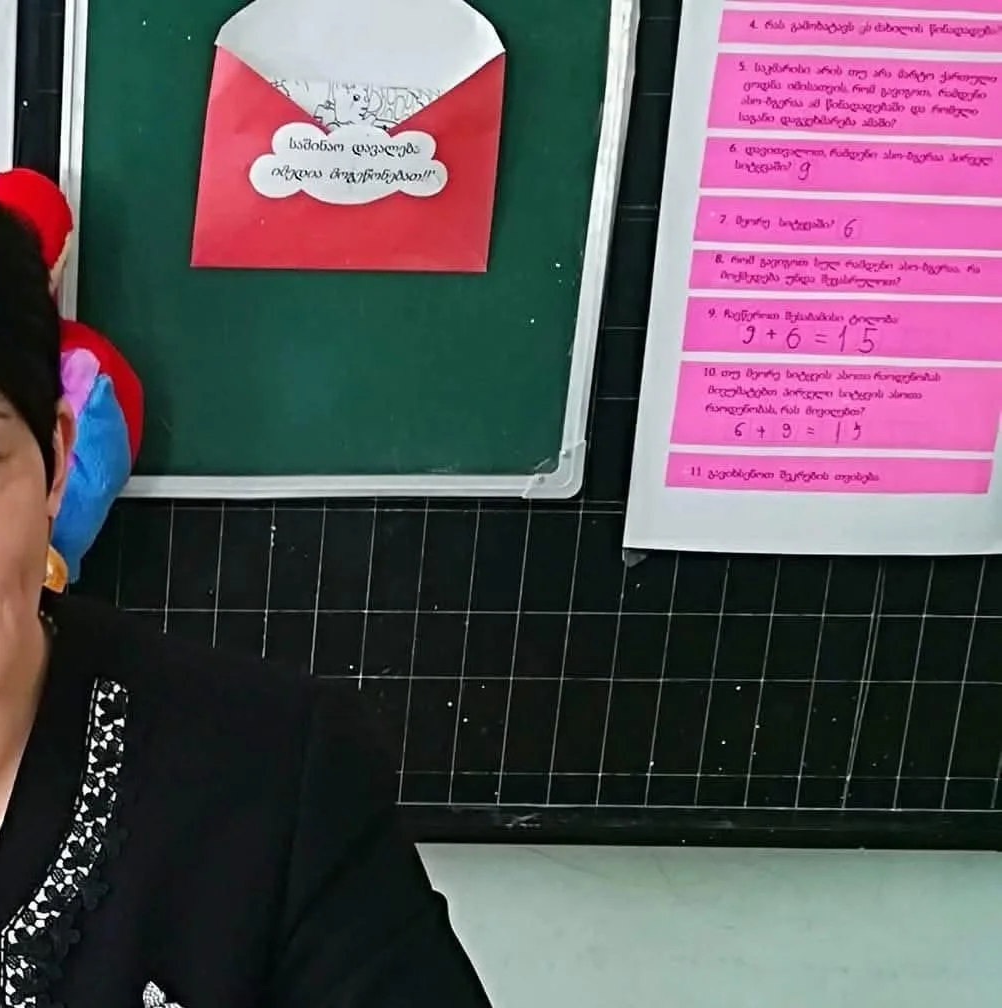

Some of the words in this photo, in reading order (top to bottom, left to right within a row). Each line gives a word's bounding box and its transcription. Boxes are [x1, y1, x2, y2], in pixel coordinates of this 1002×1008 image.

[764, 19, 785, 31] რას
[754, 62, 810, 76] საკმარისი
[815, 65, 843, 77] არის
[847, 69, 868, 81] თუ
[872, 67, 892, 79] არა
[897, 69, 936, 83] მარტო
[939, 71, 998, 86] ქართული
[742, 80, 782, 92] ცოდნა
[851, 83, 876, 95] რომ
[937, 87, 988, 102] რამდენი
[738, 111, 775, 126] საგანი
[909, 103, 926, 116] და
[931, 103, 980, 118] რომელი
[288, 137, 345, 153] საშინაო
[351, 141, 421, 158] დავალება
[829, 148, 878, 162] რამდენი
[270, 165, 323, 182] იმედია
[735, 215, 771, 230] მეორე
[843, 218, 858, 239] 6
[730, 254, 755, 265] რომ
[813, 256, 841, 272] სულ
[844, 259, 894, 273] რამდენი
[966, 263, 981, 274] რა
[720, 269, 781, 285] მოქმედება
[784, 274, 816, 287] უნდა
[741, 323, 756, 345] 9
[786, 326, 802, 350] 6
[720, 369, 742, 381] თუ
[745, 368, 781, 381] მეორე
[785, 368, 832, 383] სიტყვის
[782, 387, 834, 400] პირველი
[838, 388, 885, 402] სიტყვის
[780, 404, 801, 415] რას
[734, 421, 747, 437] 6
[781, 422, 793, 440] 9
[707, 466, 775, 481] გავიხსენოთ
[779, 469, 830, 483] შეკრების
